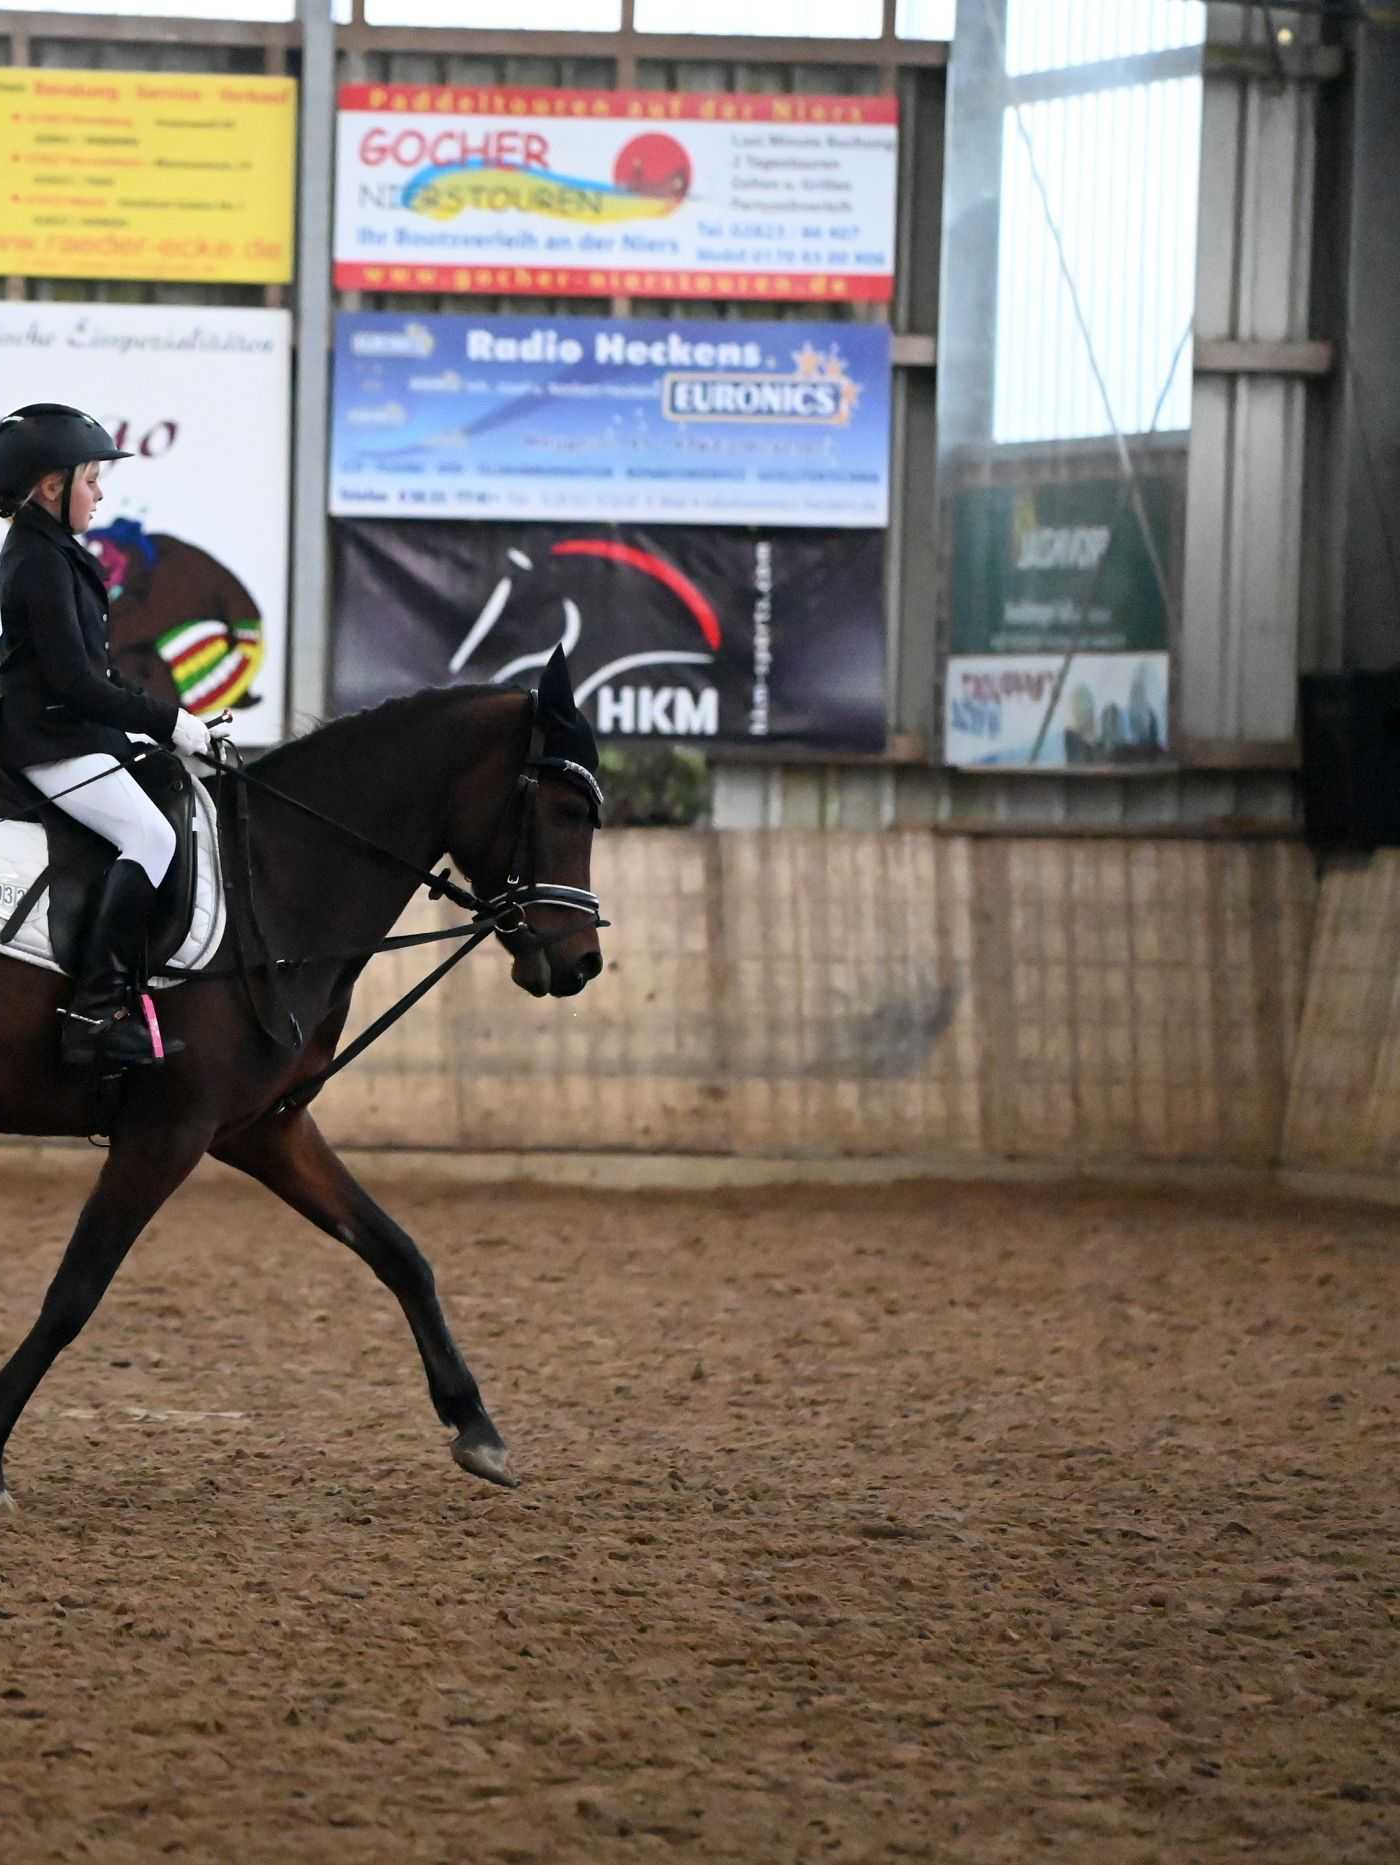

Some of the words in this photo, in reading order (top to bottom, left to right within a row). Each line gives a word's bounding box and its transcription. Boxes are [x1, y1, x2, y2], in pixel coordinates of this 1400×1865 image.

[359, 128, 550, 171] GOCHER
[466, 330, 584, 364] Radio
[594, 332, 762, 368] Heckens
[674, 380, 836, 416] EURONICS
[599, 686, 718, 736] HKM
